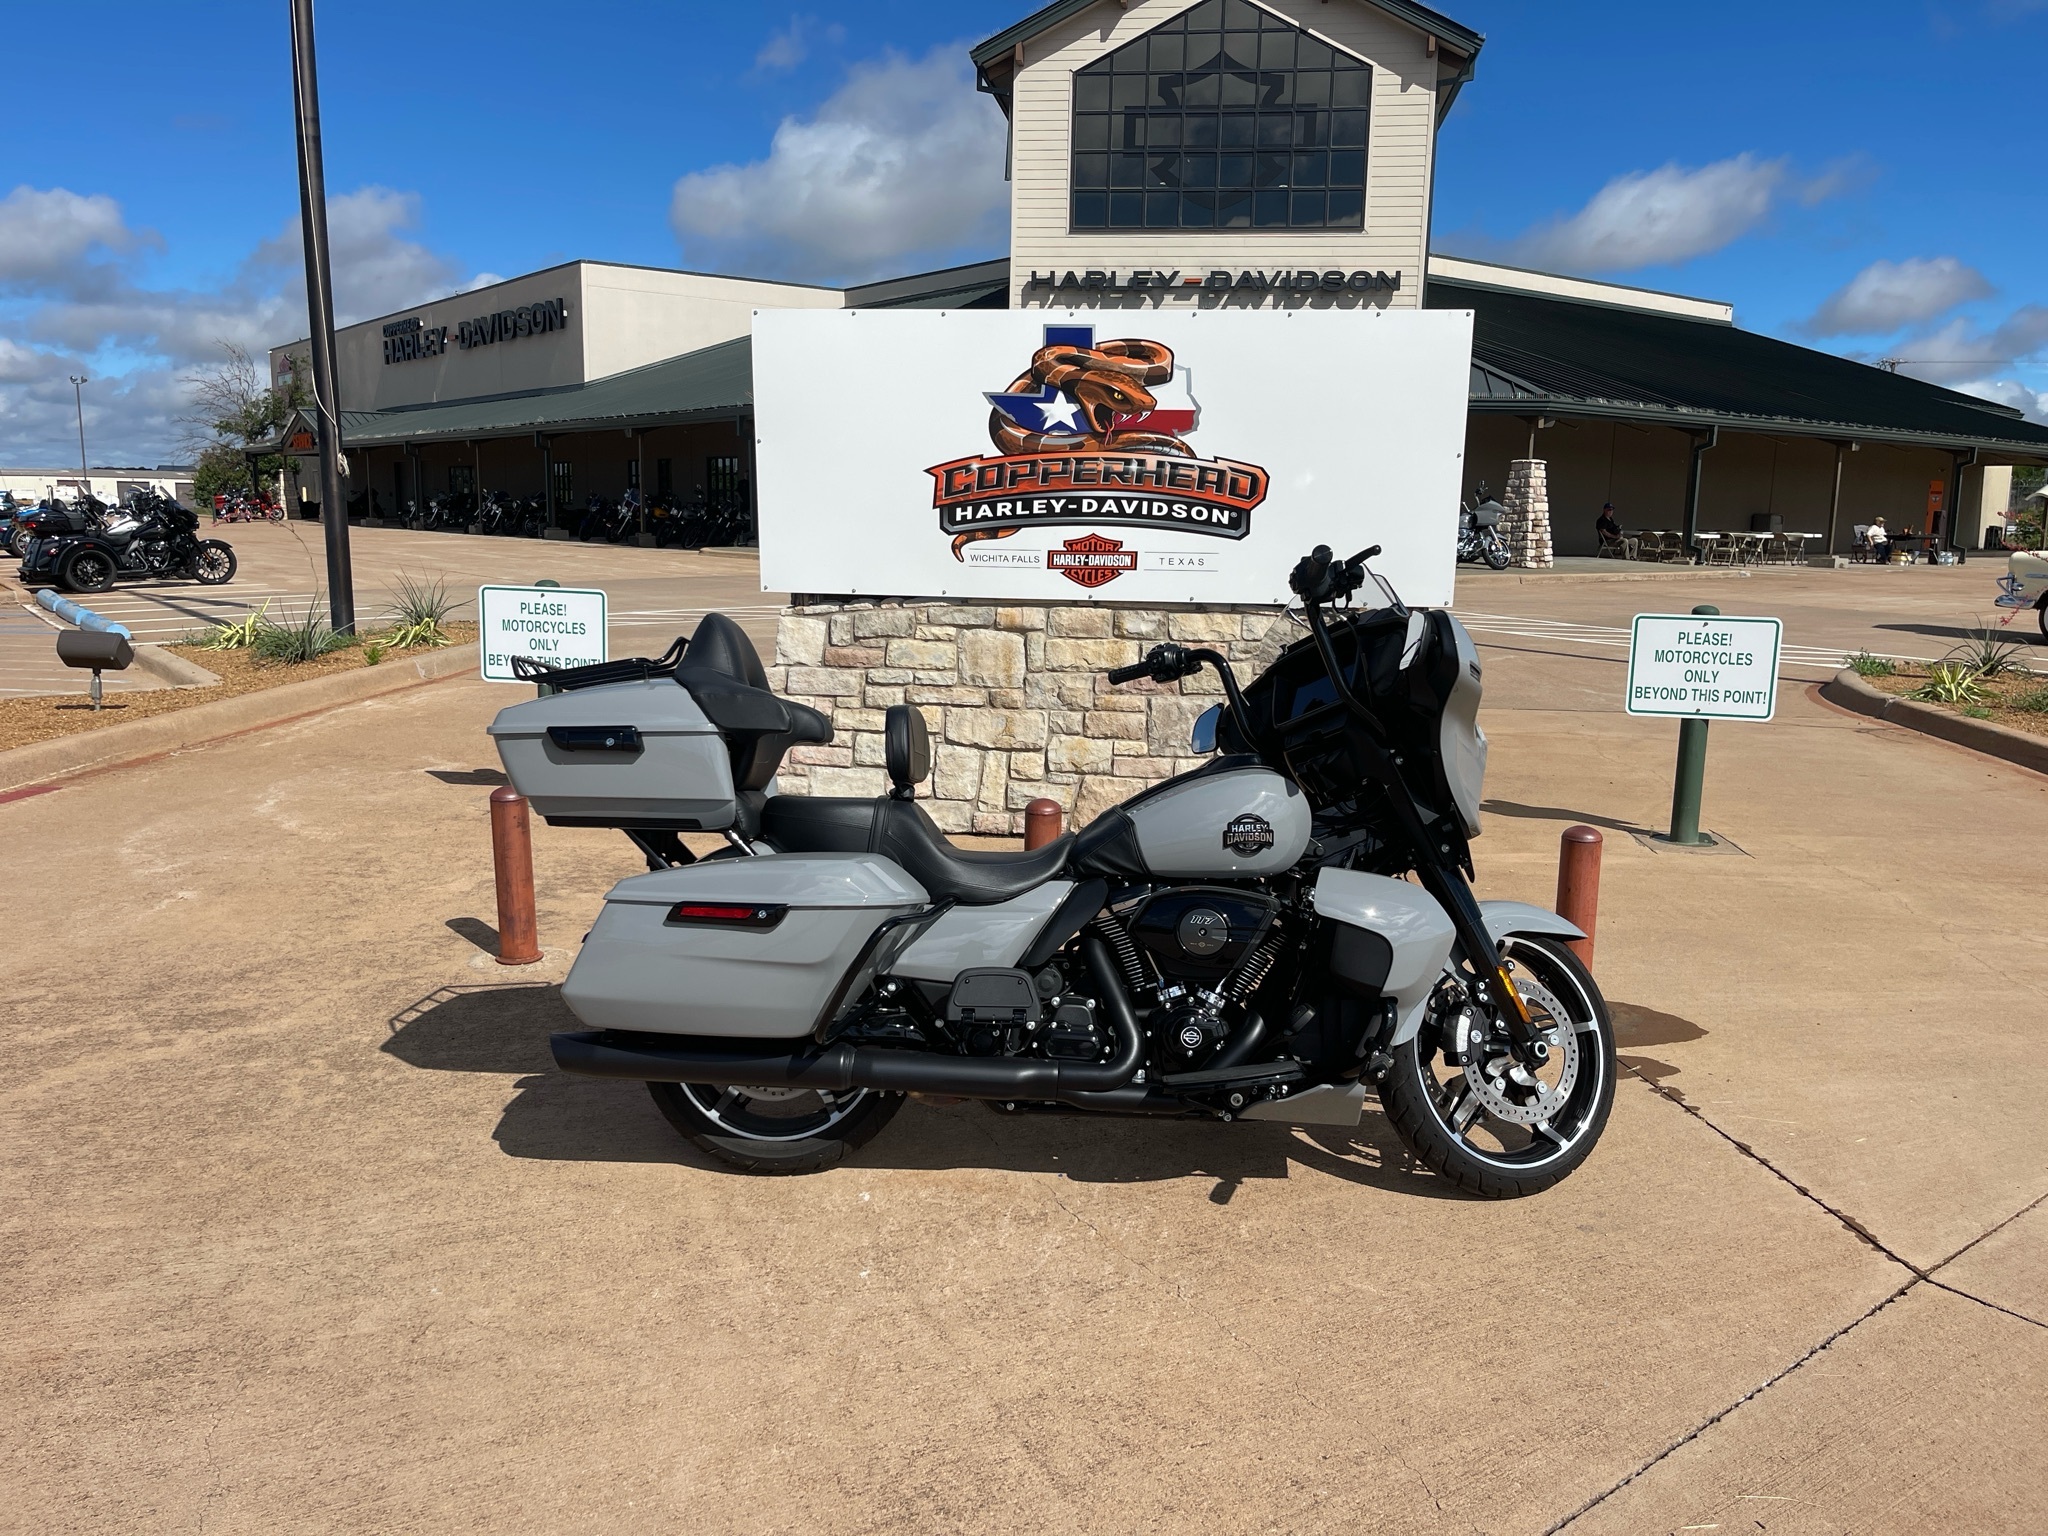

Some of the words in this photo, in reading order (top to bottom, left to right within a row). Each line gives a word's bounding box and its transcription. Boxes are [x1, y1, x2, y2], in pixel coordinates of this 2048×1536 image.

[1030, 270, 1401, 292] HARLEY-DAVIDSON
[942, 456, 1259, 501] COPPERHEAD
[955, 498, 1231, 525] HARLEY-DAVIDSON
[1072, 538, 1114, 551] MOTOR
[970, 554, 1009, 564] WICHITA
[1011, 554, 1040, 564] FALLS
[1053, 554, 1132, 567] HARLEY-DAVIDSON
[1159, 557, 1205, 566] TEXAS
[1071, 569, 1113, 583] CYCLES
[520, 602, 567, 616] PLEASE!
[502, 619, 586, 635] MOTORCYCLES
[529, 638, 559, 651] ONLY
[1677, 632, 1732, 646] PLEASE!
[1654, 650, 1753, 666] MOTORCYCLES
[1684, 669, 1720, 684] ONLY
[1634, 686, 1687, 701] BEYOND
[1691, 689, 1720, 702] THIS
[1723, 691, 1767, 705] POINT!
[1227, 832, 1273, 844] DAVIDSON
